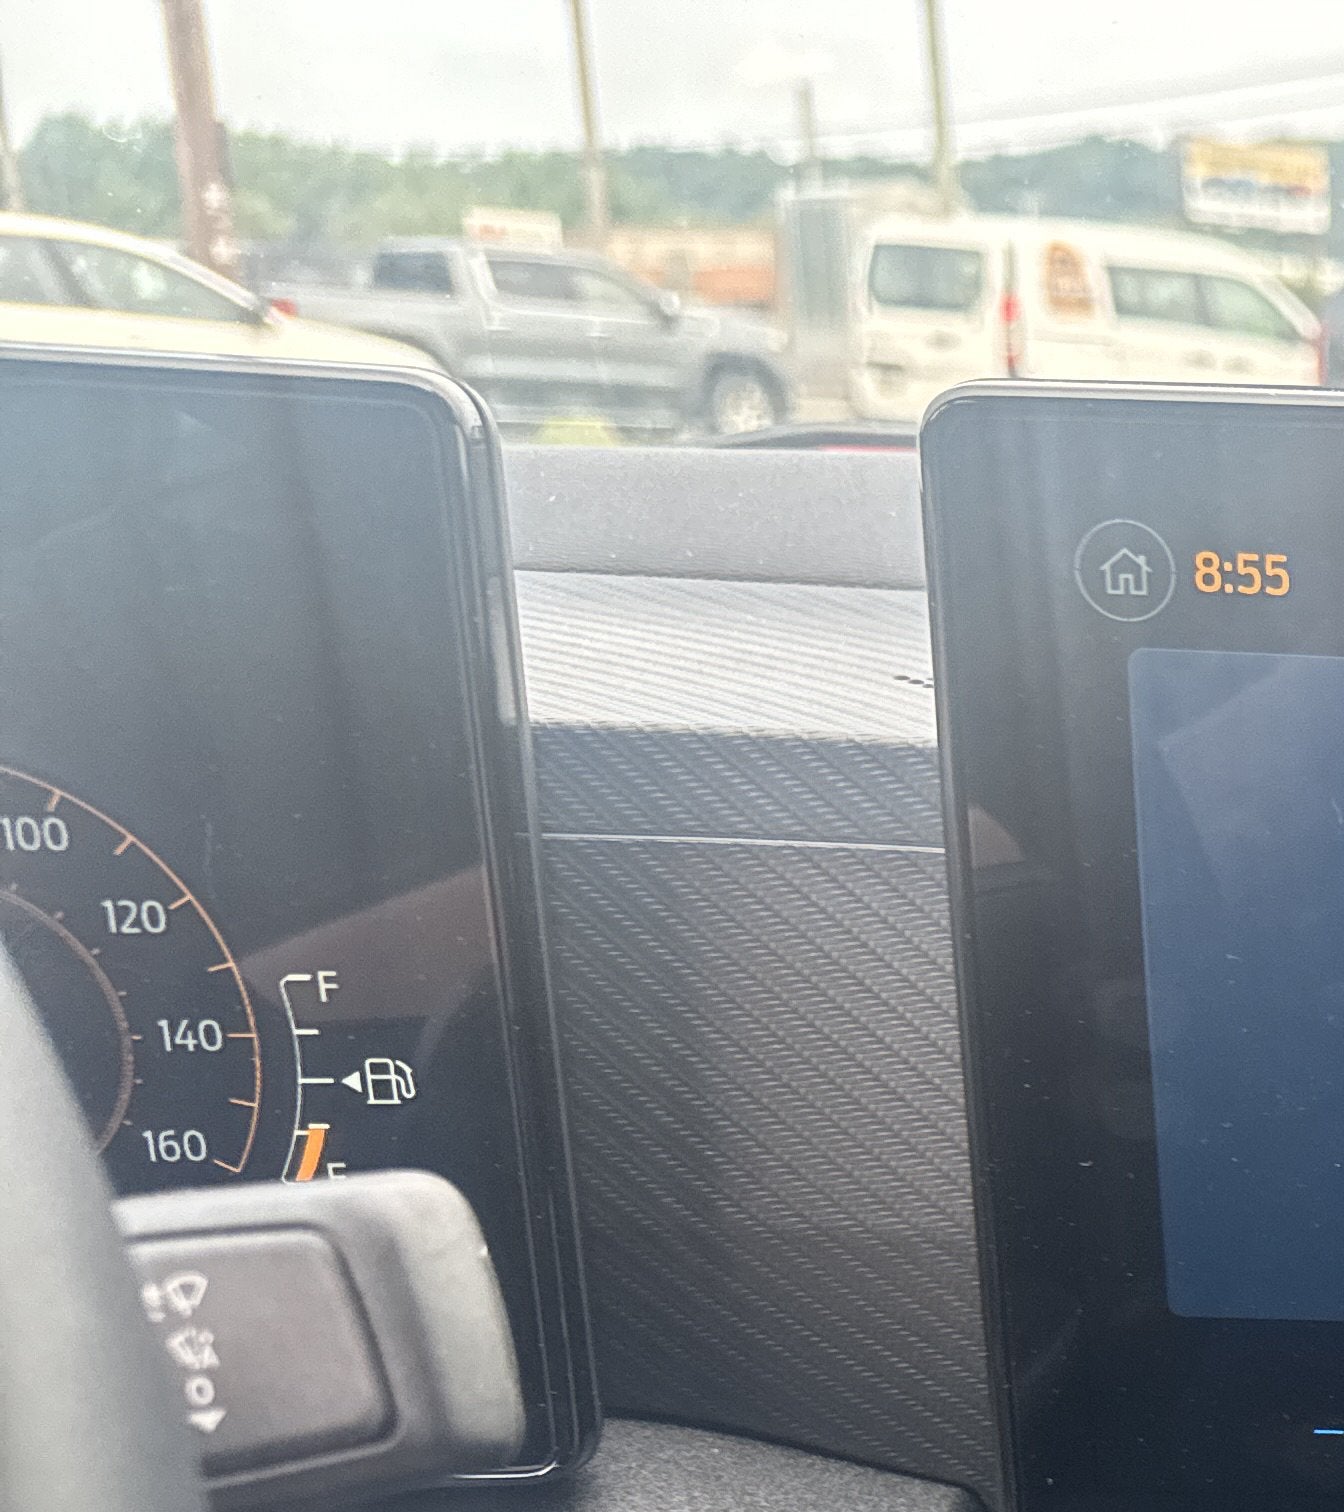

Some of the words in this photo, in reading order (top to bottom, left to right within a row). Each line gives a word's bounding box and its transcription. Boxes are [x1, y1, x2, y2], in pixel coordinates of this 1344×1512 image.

[1194, 550, 1291, 596] 8:55
[0, 816, 69, 851] 100
[101, 899, 168, 935] 120
[316, 970, 340, 1003] F
[157, 1019, 225, 1053] 140
[141, 1130, 208, 1164] 160
